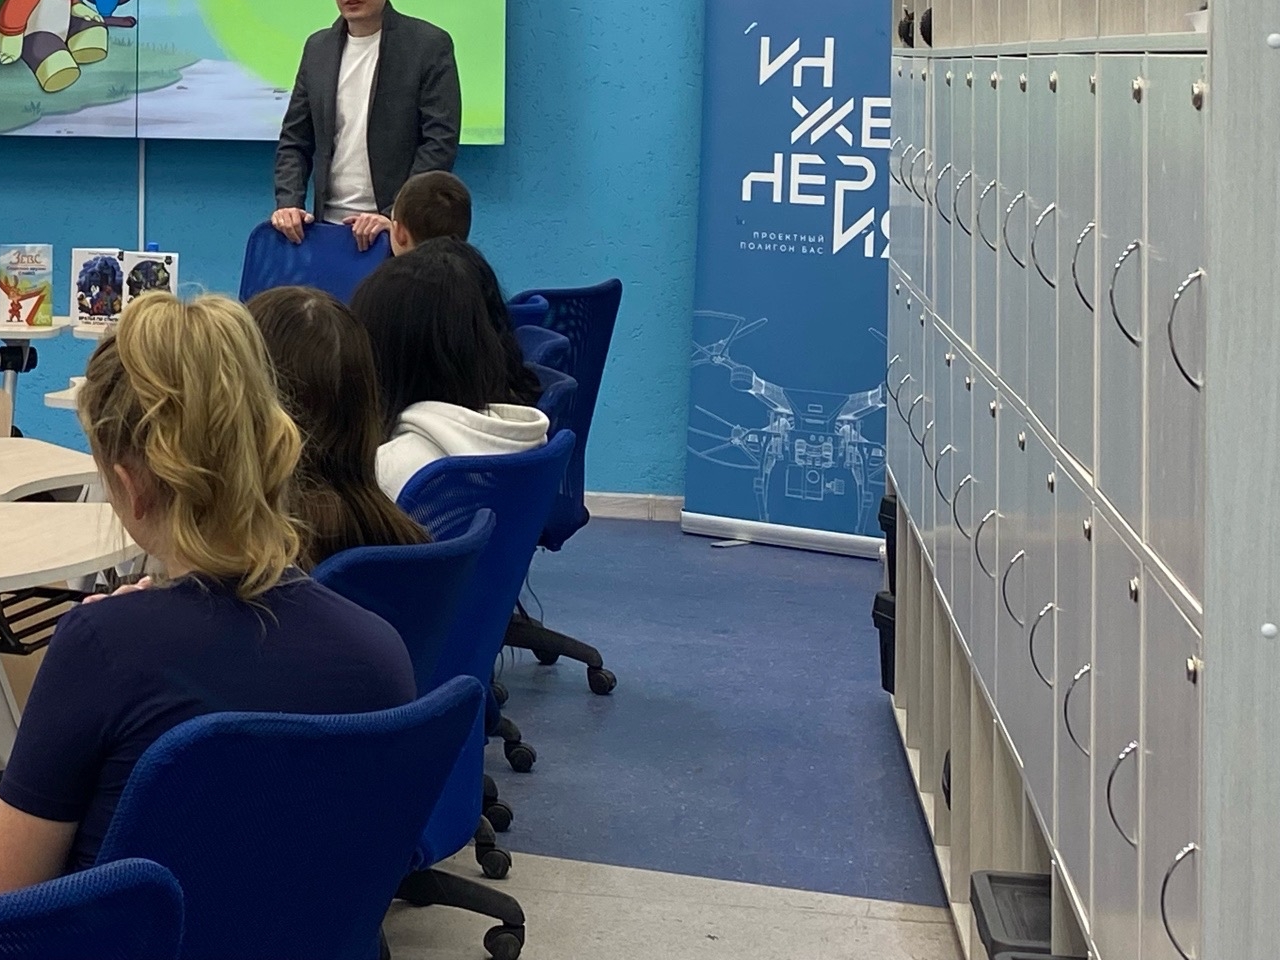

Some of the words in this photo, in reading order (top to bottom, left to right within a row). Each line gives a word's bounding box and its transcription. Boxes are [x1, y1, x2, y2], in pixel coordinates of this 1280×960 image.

[753, 231, 825, 244] ПРОЕКТНЫЙ
[740, 241, 795, 253] ПОЛИГОН
[802, 245, 824, 255] БАС
